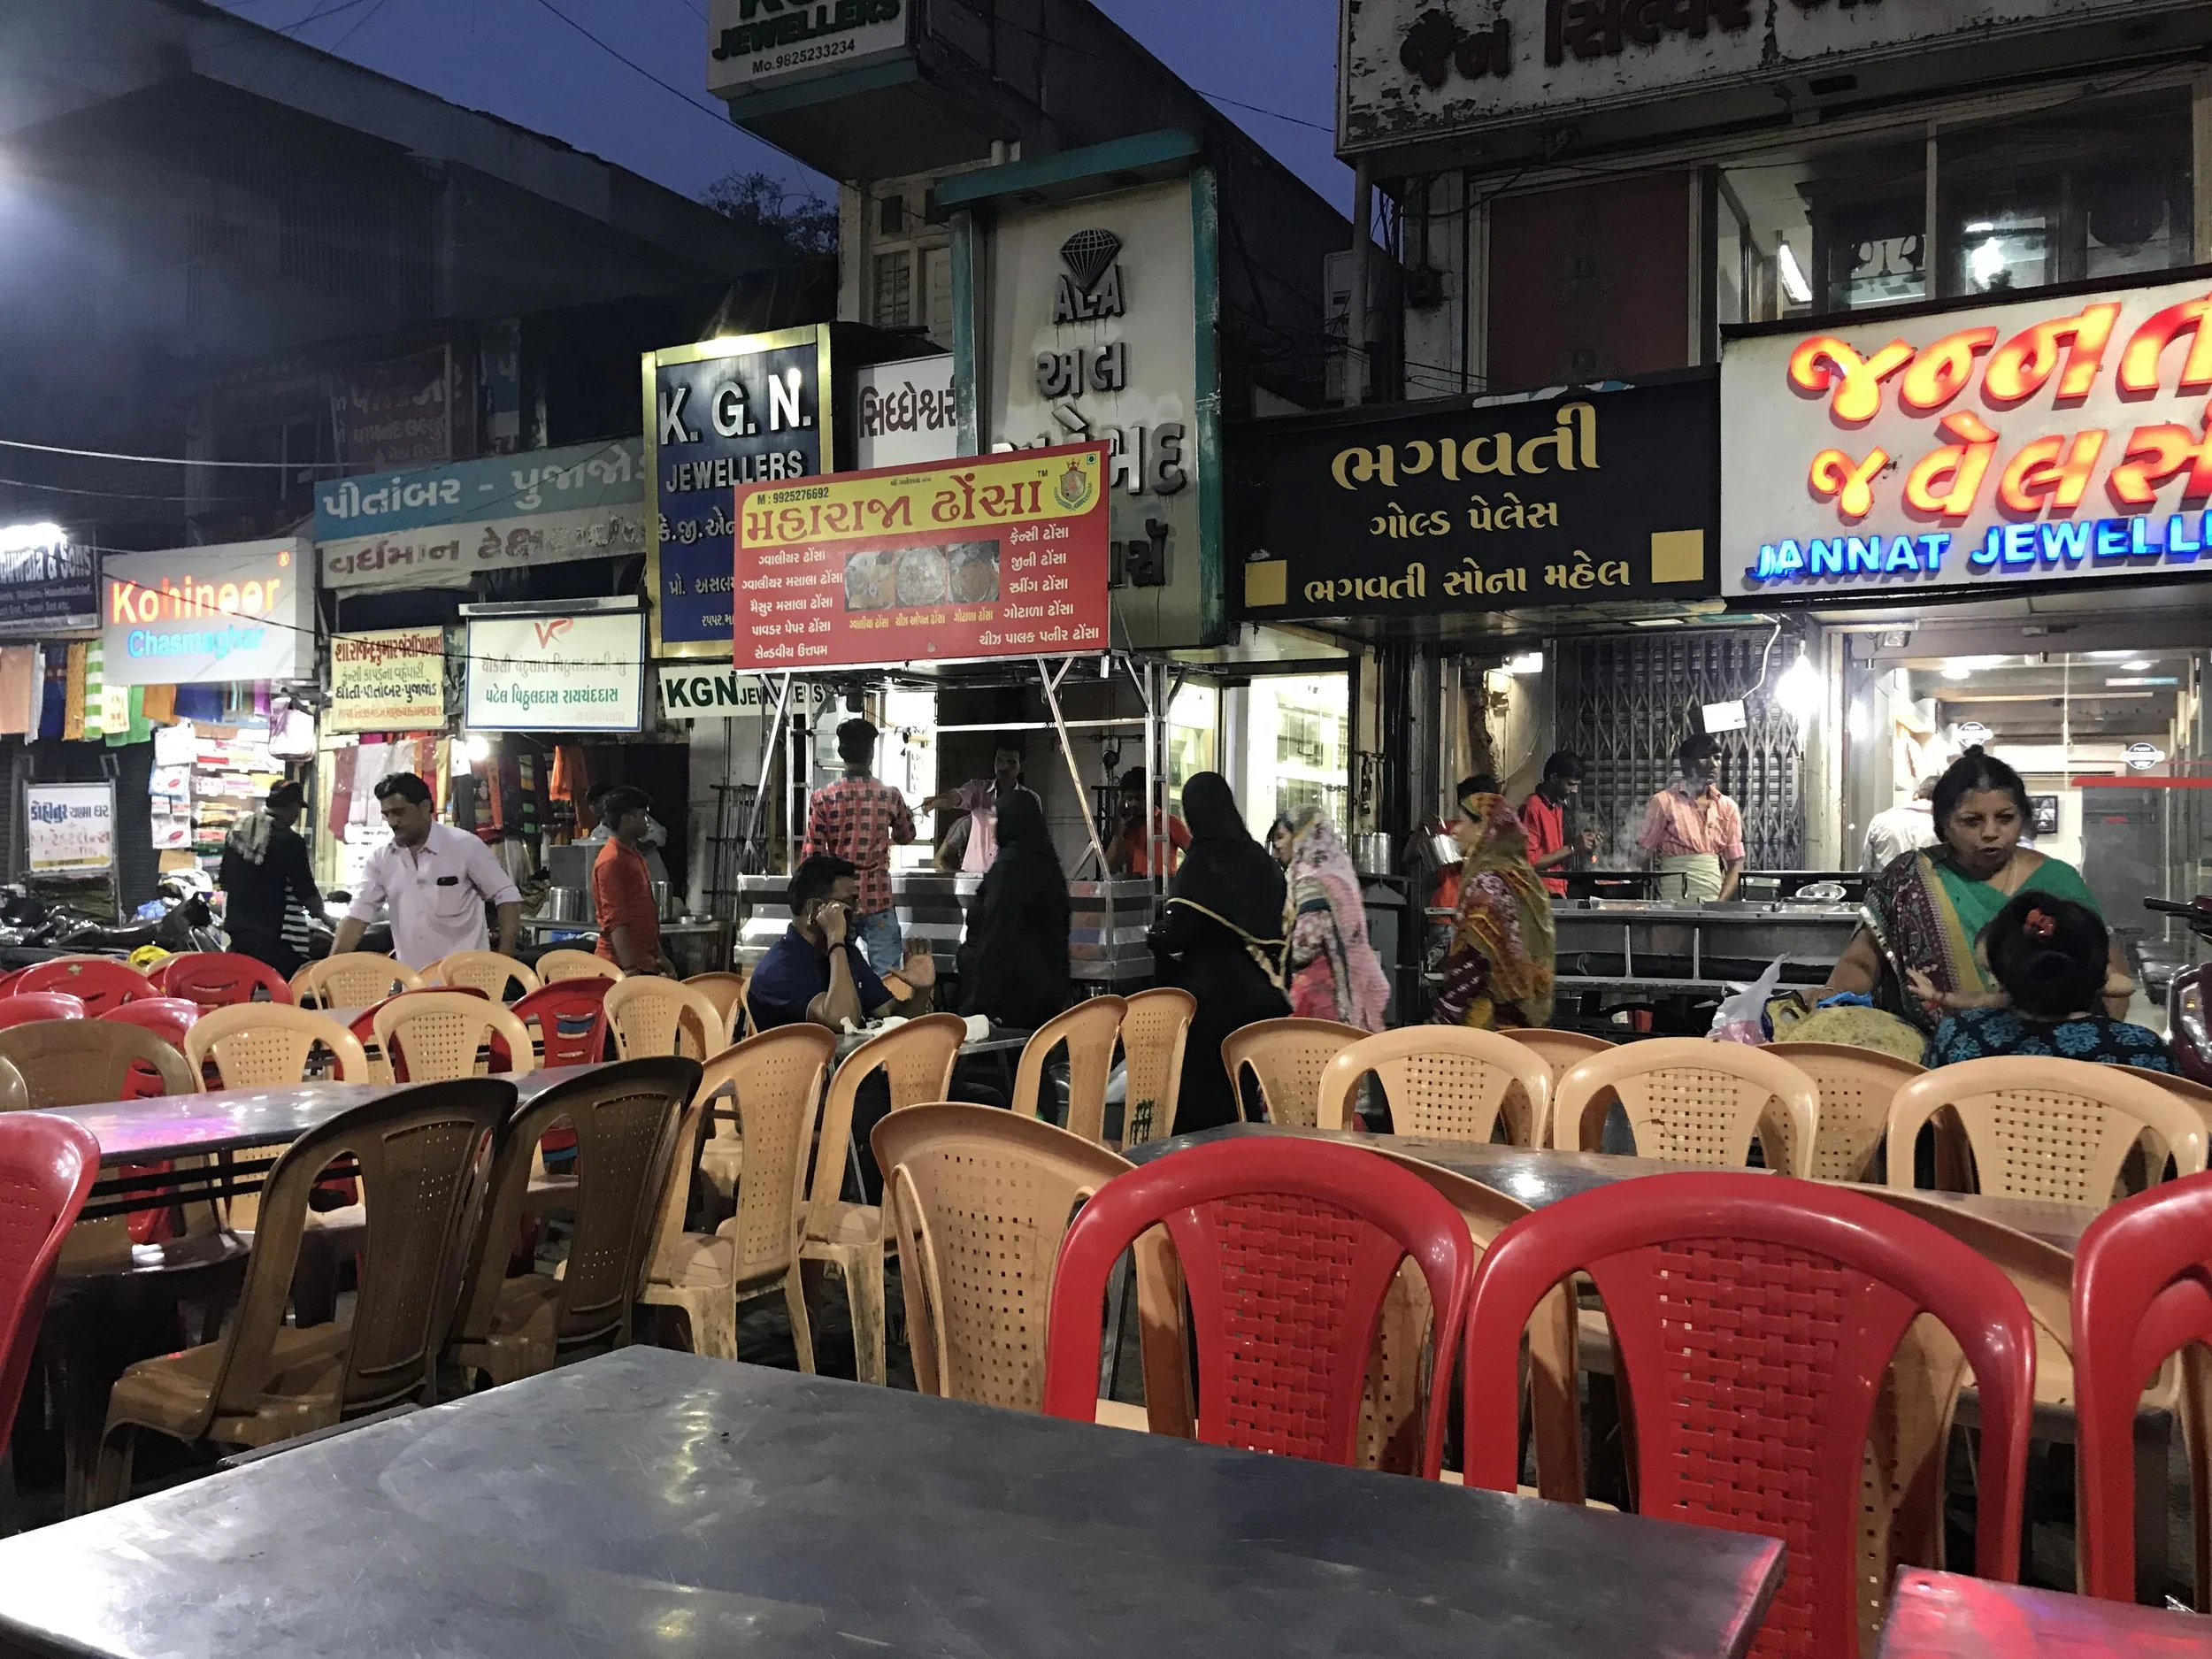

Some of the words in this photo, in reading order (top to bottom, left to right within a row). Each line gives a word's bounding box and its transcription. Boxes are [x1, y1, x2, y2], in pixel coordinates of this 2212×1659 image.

[1331, 401, 1601, 490] ભગવતી
[665, 449, 803, 493] JEWELLERS
[323, 476, 461, 518] પીતાંબર
[773, 487, 829, 503] 9925276692
[746, 495, 913, 542] મહારાજા
[932, 472, 1042, 523] ઢોંસા
[1369, 502, 1451, 539] ગોલ્ડ
[1467, 492, 1559, 533] પેલેસ
[1010, 526, 1038, 545] ફેન્સી
[1043, 524, 1069, 540] ઢોંસા
[803, 547, 826, 562] ઢોંસા
[1747, 534, 1952, 581] JANNAT
[1970, 510, 2212, 567] JEWELL
[1041, 549, 1066, 566] ઢોંસા
[786, 575, 817, 587] મસાલા
[820, 570, 842, 585] ઢોંસા
[1042, 575, 1068, 591] ઢોંસા
[1303, 562, 1427, 603] ભગવતી
[1442, 557, 1528, 597] સોના
[1544, 549, 1631, 591] મહેલ
[776, 600, 807, 611] મસાલા
[810, 594, 833, 609] ઢોંસા
[1003, 603, 1043, 618] ગોટાળા
[1048, 600, 1073, 616] ઢોંસા
[751, 625, 781, 635] પાવડર
[785, 619, 804, 634] પેપર
[808, 618, 831, 633] ઢોંસા
[979, 630, 1001, 645] ચીઝ
[1005, 632, 1035, 644] પાલક
[1040, 626, 1068, 641] પનીર
[1072, 624, 1099, 640] ઢોંસા
[486, 683, 508, 704] પટેલ
[665, 677, 740, 708] KGN
